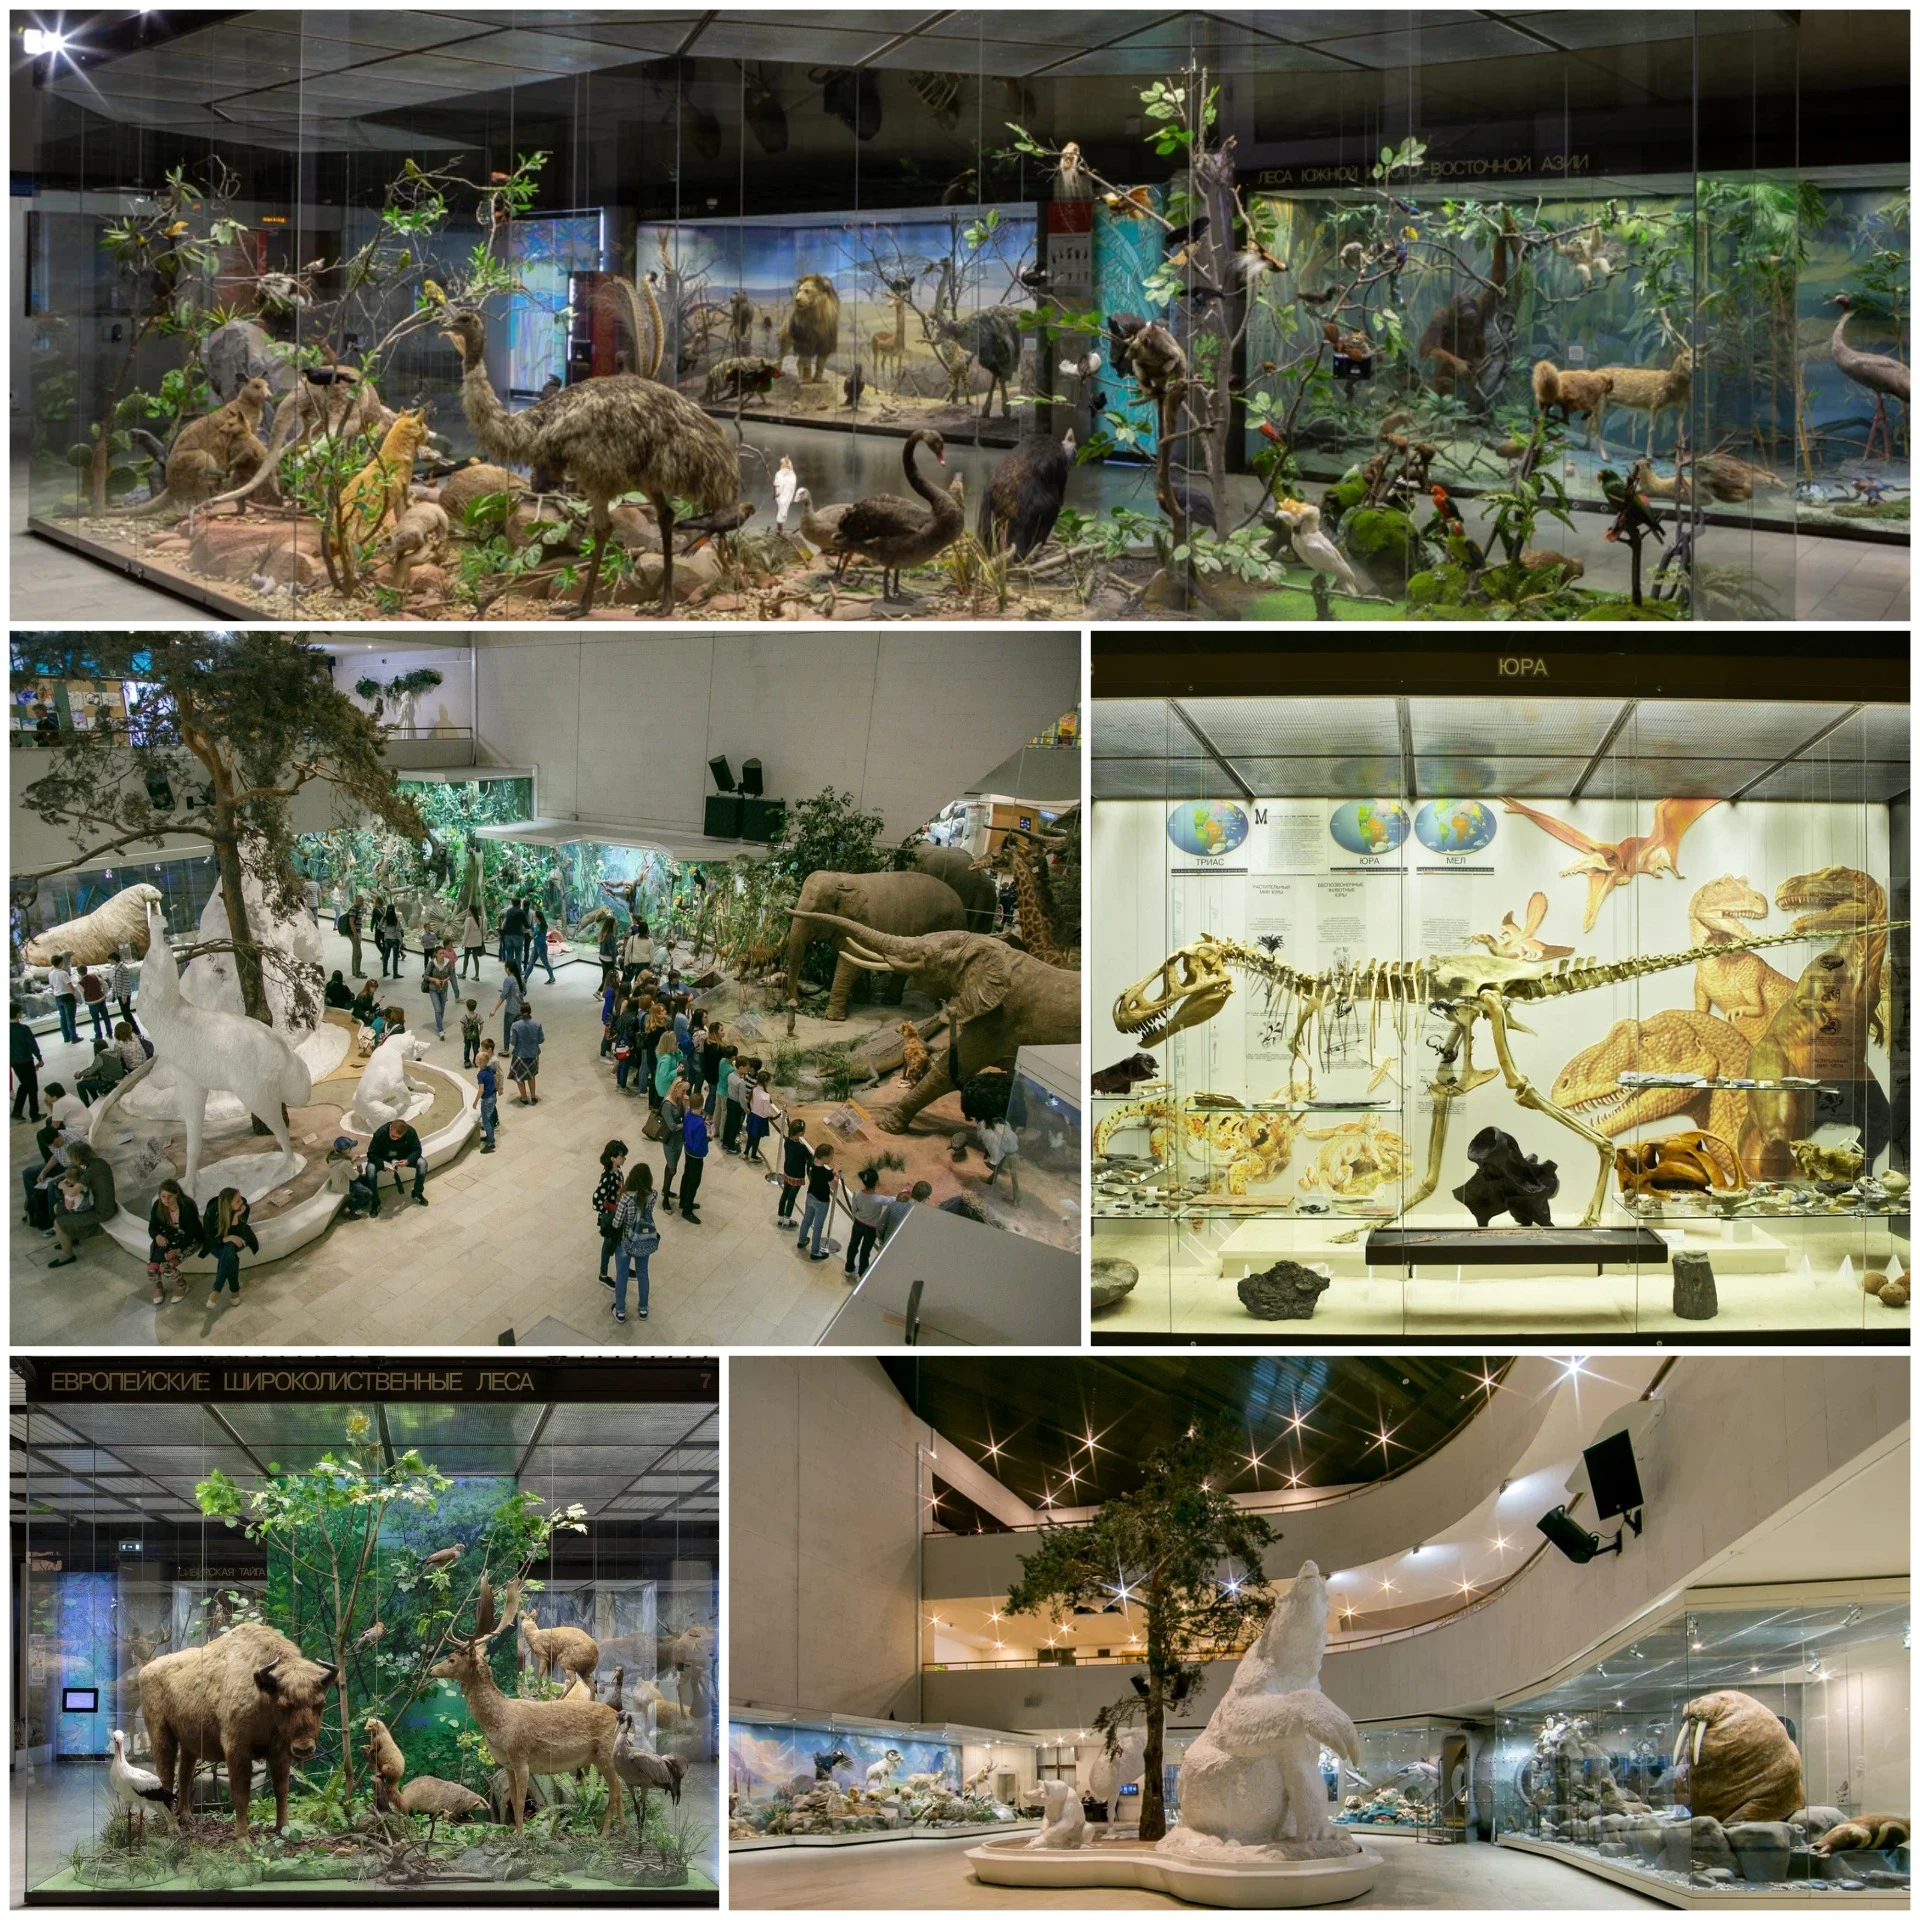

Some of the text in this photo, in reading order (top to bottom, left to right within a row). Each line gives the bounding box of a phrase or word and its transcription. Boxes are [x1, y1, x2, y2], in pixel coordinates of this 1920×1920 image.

[1258, 169, 1293, 185] ЛЕСА
[1301, 164, 1359, 183] ЮЖНОЙ
[1540, 153, 1589, 172] АЗИИ
[1498, 657, 1549, 676] ЮРА
[1195, 857, 1225, 866] ТРИАС
[1358, 856, 1381, 865] ЮРА
[1445, 856, 1467, 865] МЕЛ
[51, 1370, 535, 1392] ЕВРОПЕЙСКИЕ ШИРОКОЛИСТВЕННЫЕ ЛЕСА
[699, 1373, 712, 1389] 7
[239, 1566, 266, 1576] ТАЙГА
